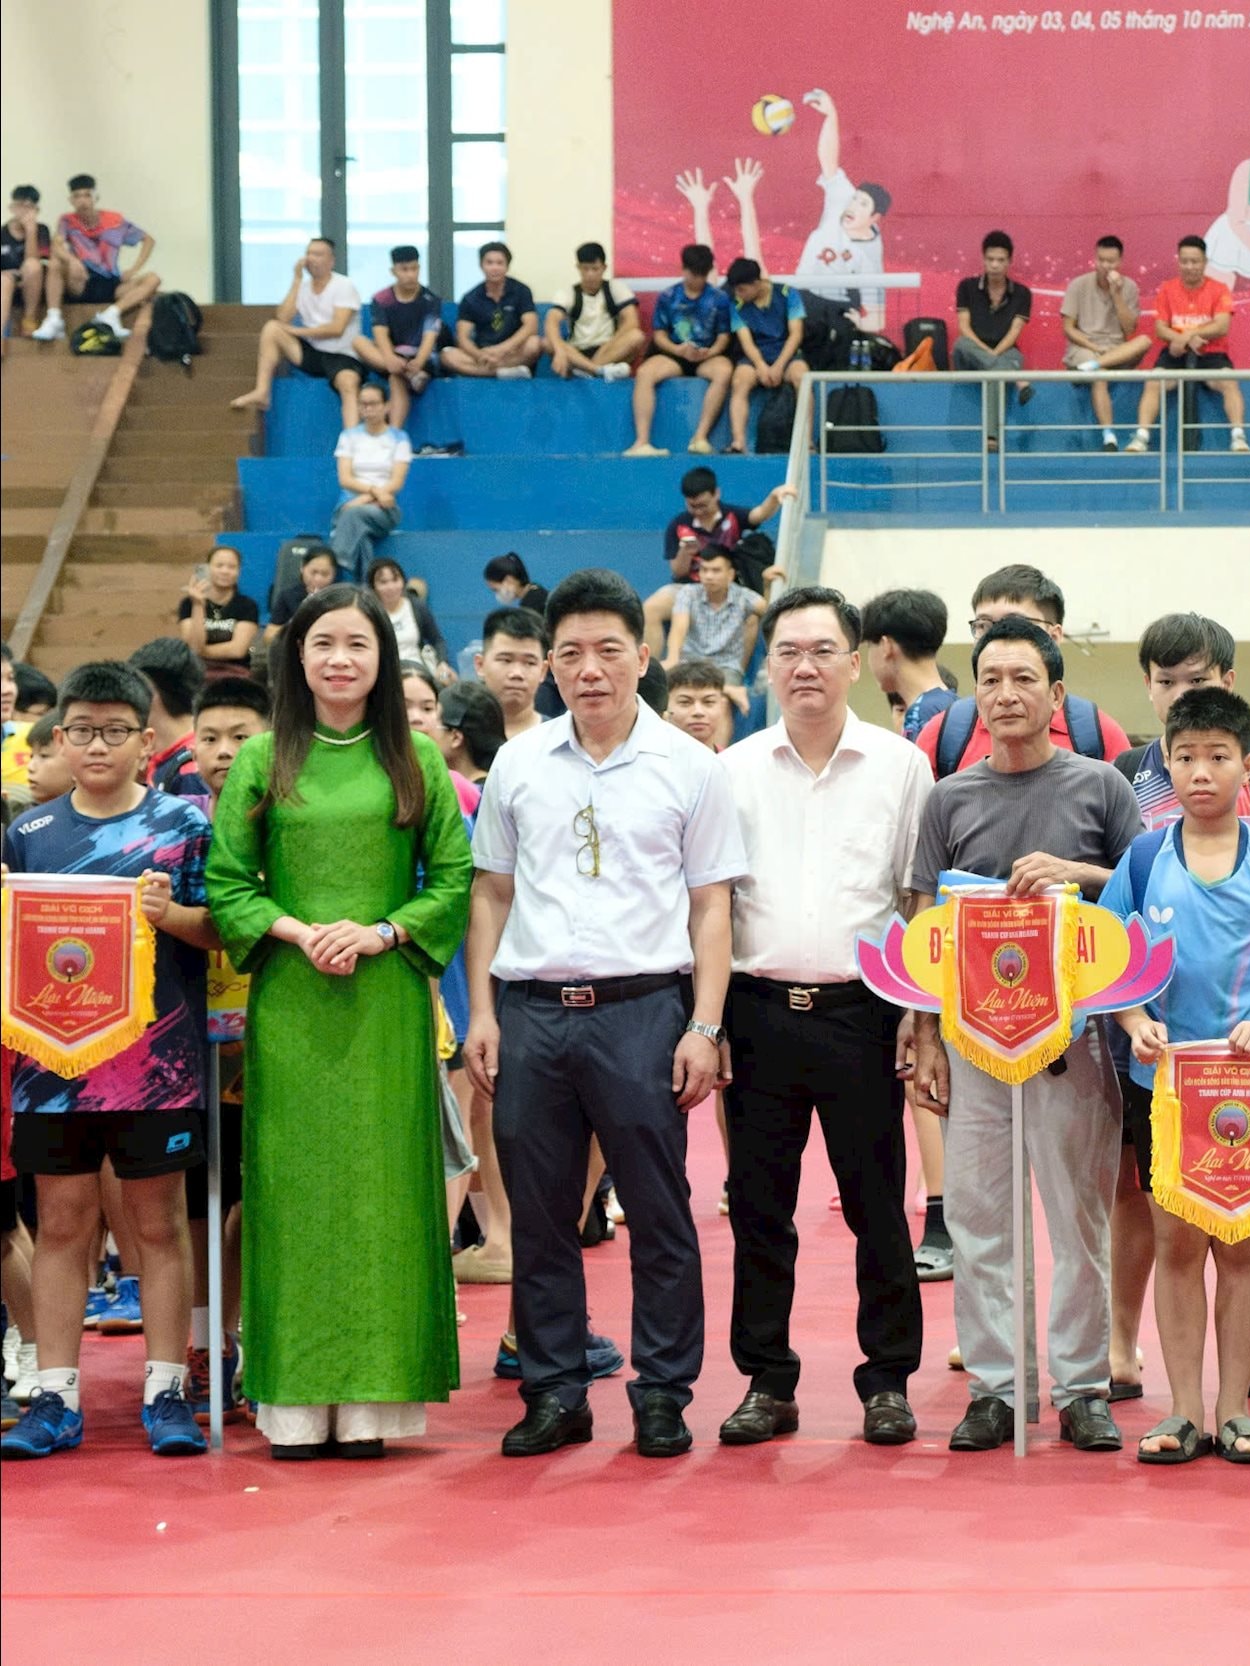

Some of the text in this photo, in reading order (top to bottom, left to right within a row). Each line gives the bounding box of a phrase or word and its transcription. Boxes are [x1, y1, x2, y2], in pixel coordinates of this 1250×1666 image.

[906, 11, 955, 35] Nghệ
[957, 12, 987, 31] An,
[991, 10, 1038, 35] ngày
[1040, 11, 1066, 32] 03,
[1070, 11, 1096, 31] 04,
[1100, 10, 1122, 29] 05
[1125, 9, 1177, 34] tháng
[1183, 10, 1200, 28] 10
[1204, 10, 1245, 28] năm
[17, 815, 54, 835] VLOOP
[1077, 917, 1095, 963] ÀI
[1224, 1065, 1238, 1075] VÔ
